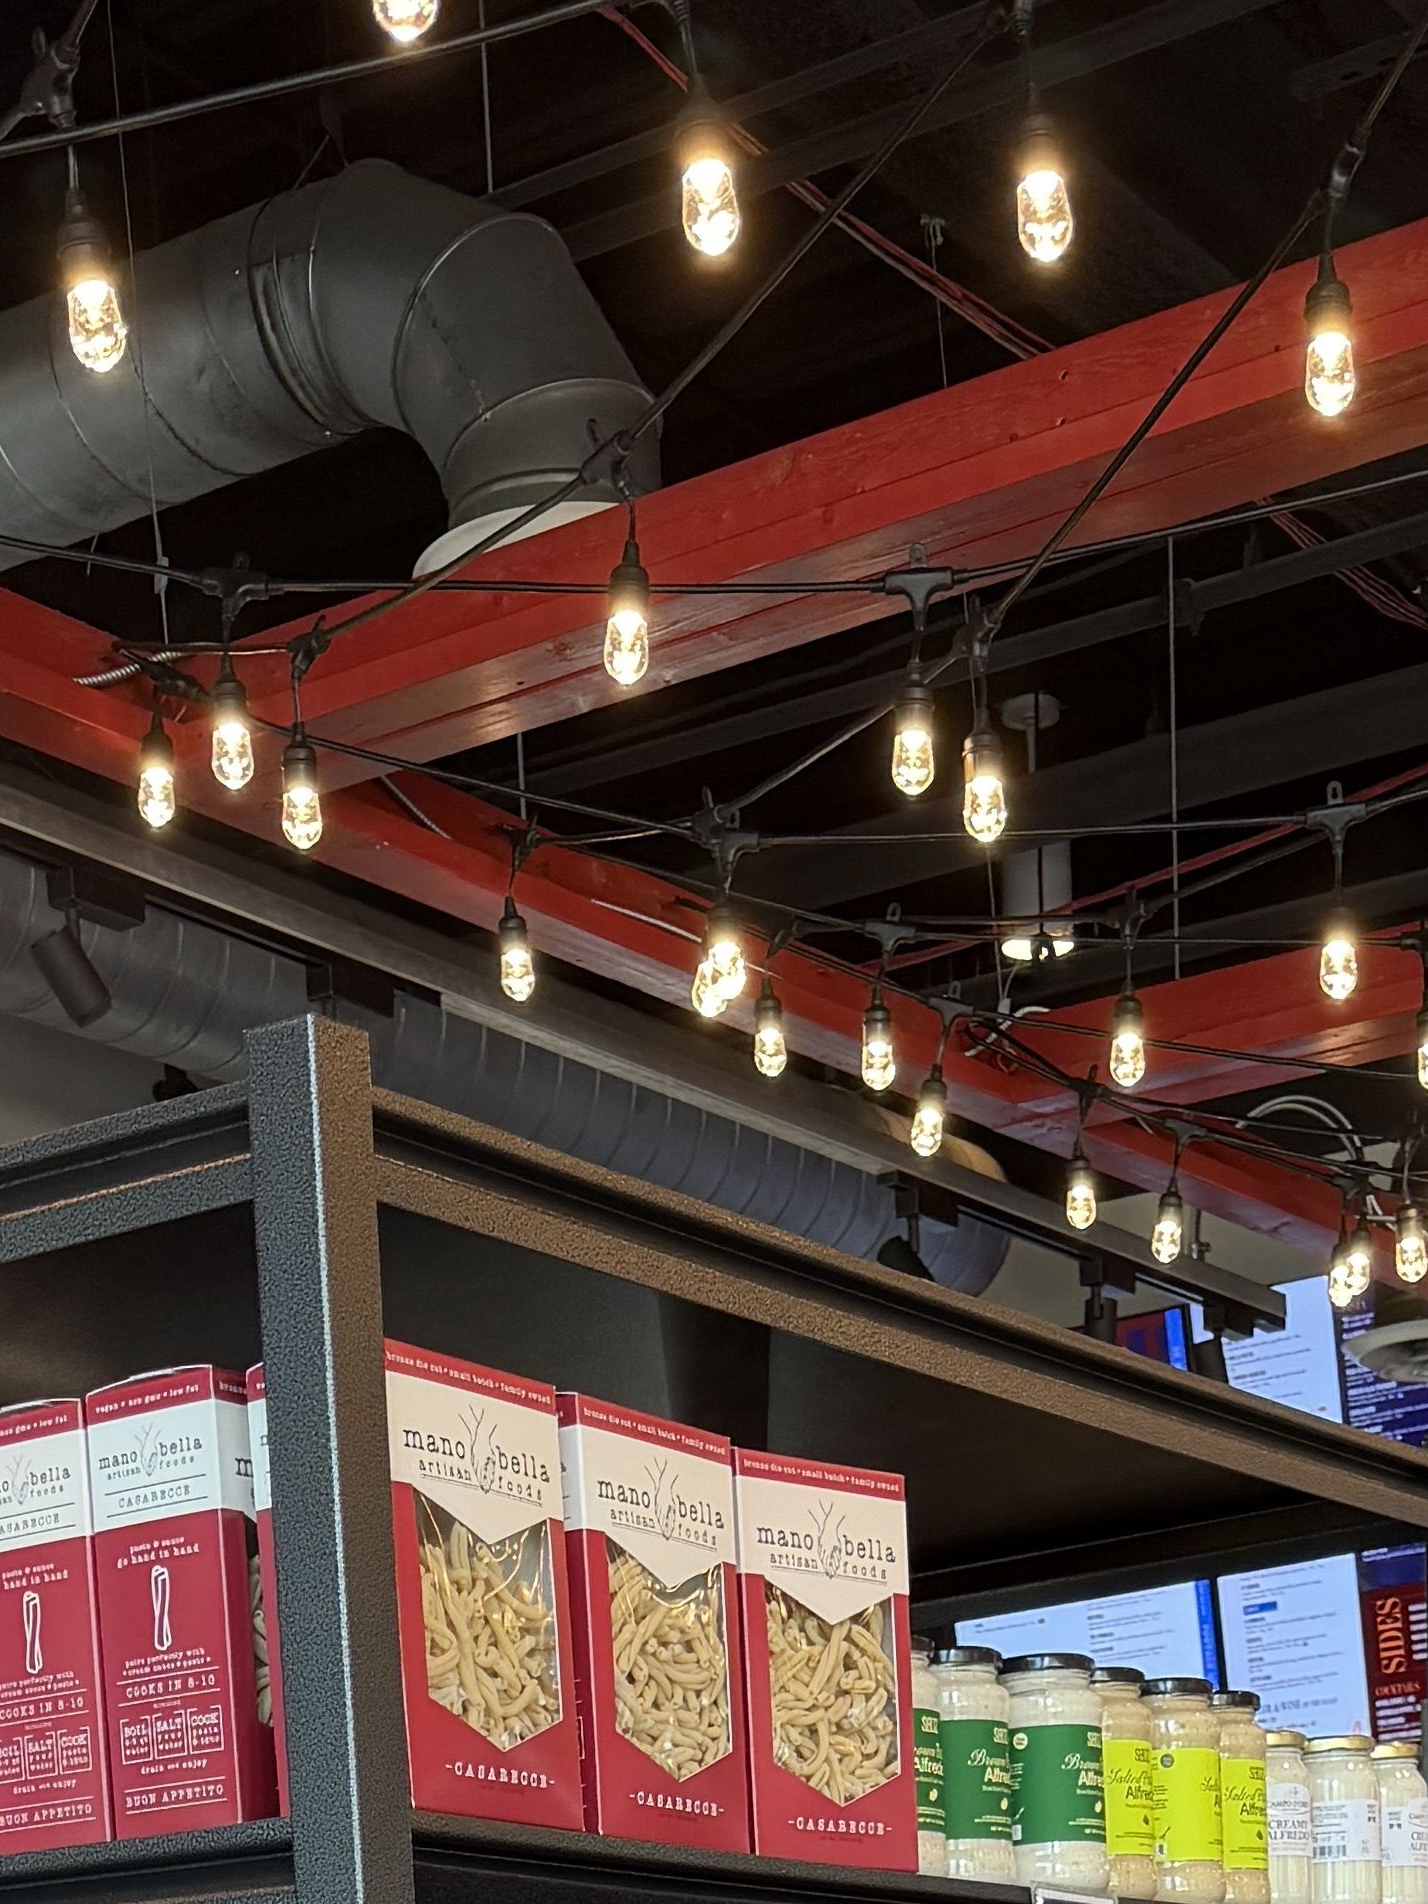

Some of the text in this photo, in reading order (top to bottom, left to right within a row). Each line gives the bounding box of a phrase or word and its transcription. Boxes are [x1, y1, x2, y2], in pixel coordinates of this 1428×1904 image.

[99, 1438, 202, 1470] mano bella
[403, 1424, 551, 1484] mano bella
[118, 1485, 190, 1508] CASARECCE
[418, 1458, 543, 1502] artisan foods
[596, 1480, 725, 1531] mano bella
[757, 1525, 896, 1565] mano bella
[1376, 1596, 1408, 1674] SIDES
[169, 1680, 182, 1692] IN
[126, 1785, 224, 1807] BUON APPETITO
